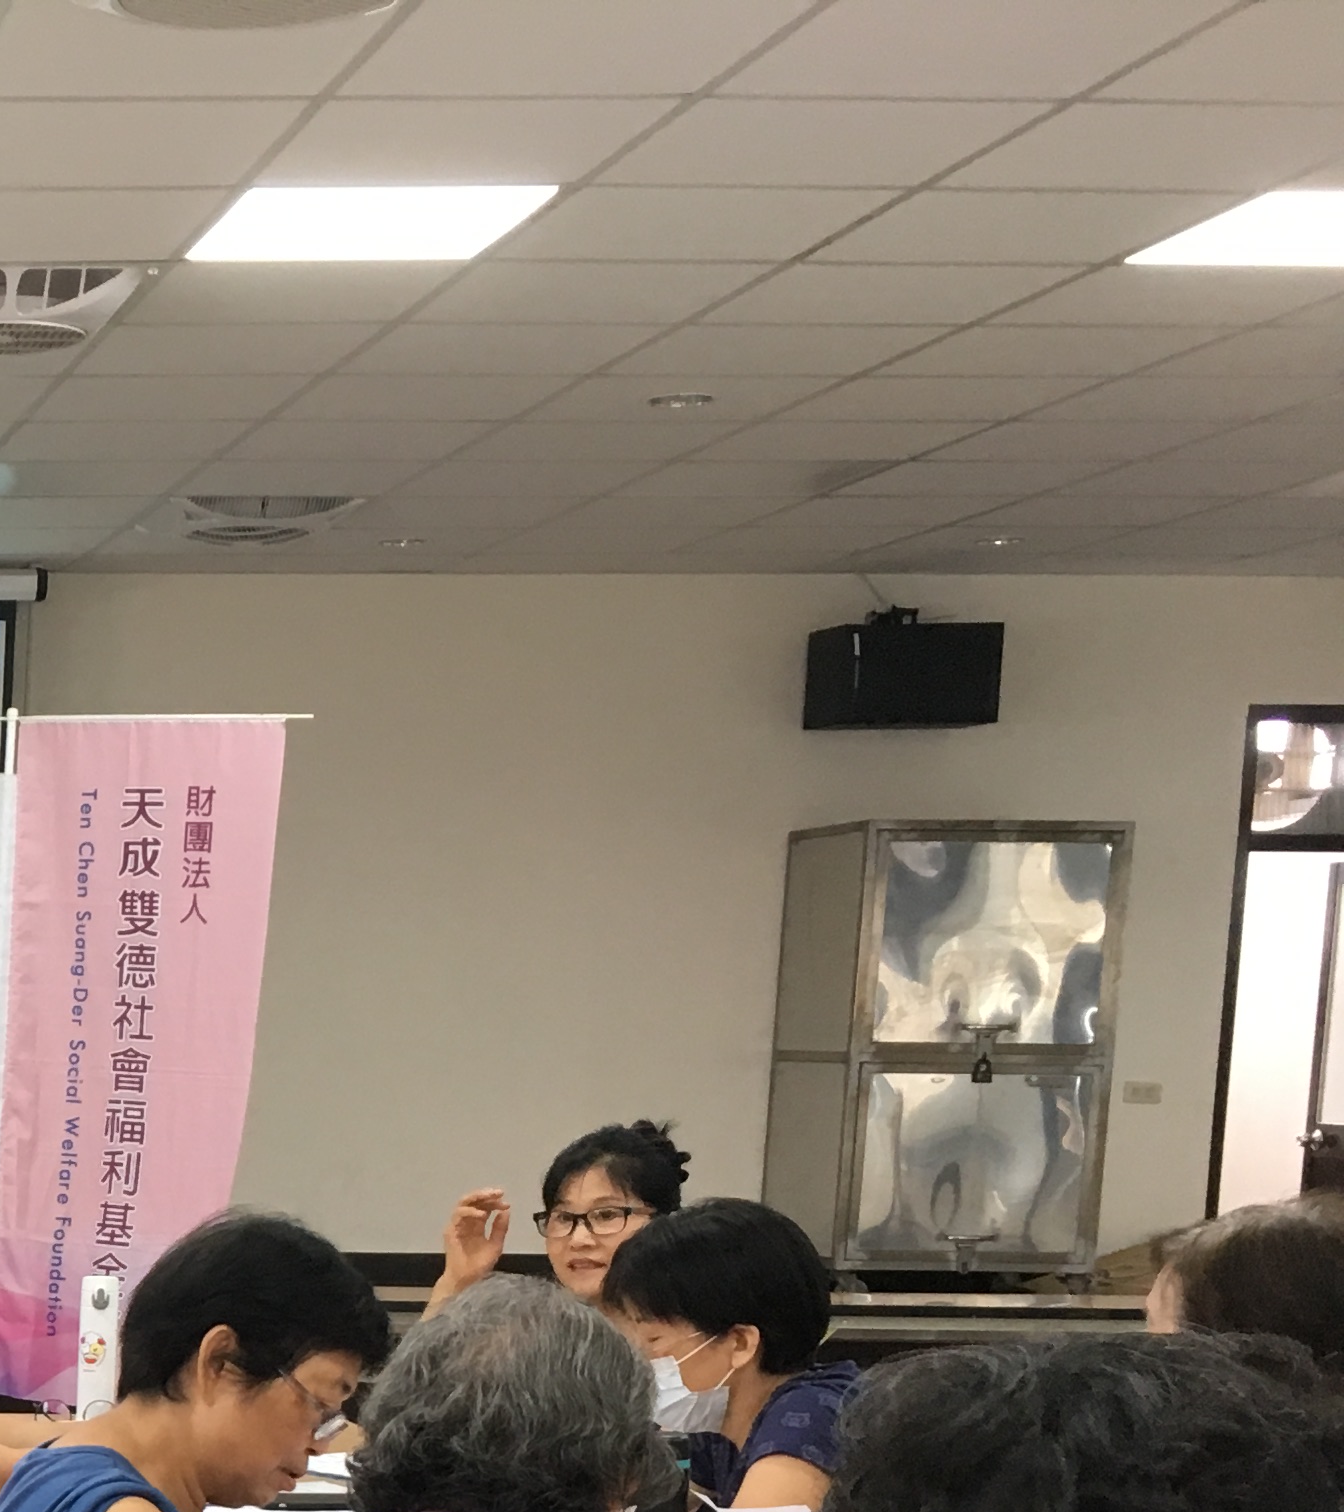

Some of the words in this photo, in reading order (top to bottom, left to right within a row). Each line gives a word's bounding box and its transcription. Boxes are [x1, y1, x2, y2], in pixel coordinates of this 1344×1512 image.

[80, 789, 97, 829] Ten
[77, 842, 94, 898] Chen
[180, 786, 216, 924] 財團法人
[71, 911, 91, 1026] Suang-Der
[66, 1040, 86, 1104] Social
[57, 1117, 80, 1205] Welfare
[46, 1217, 71, 1336] Foundation
